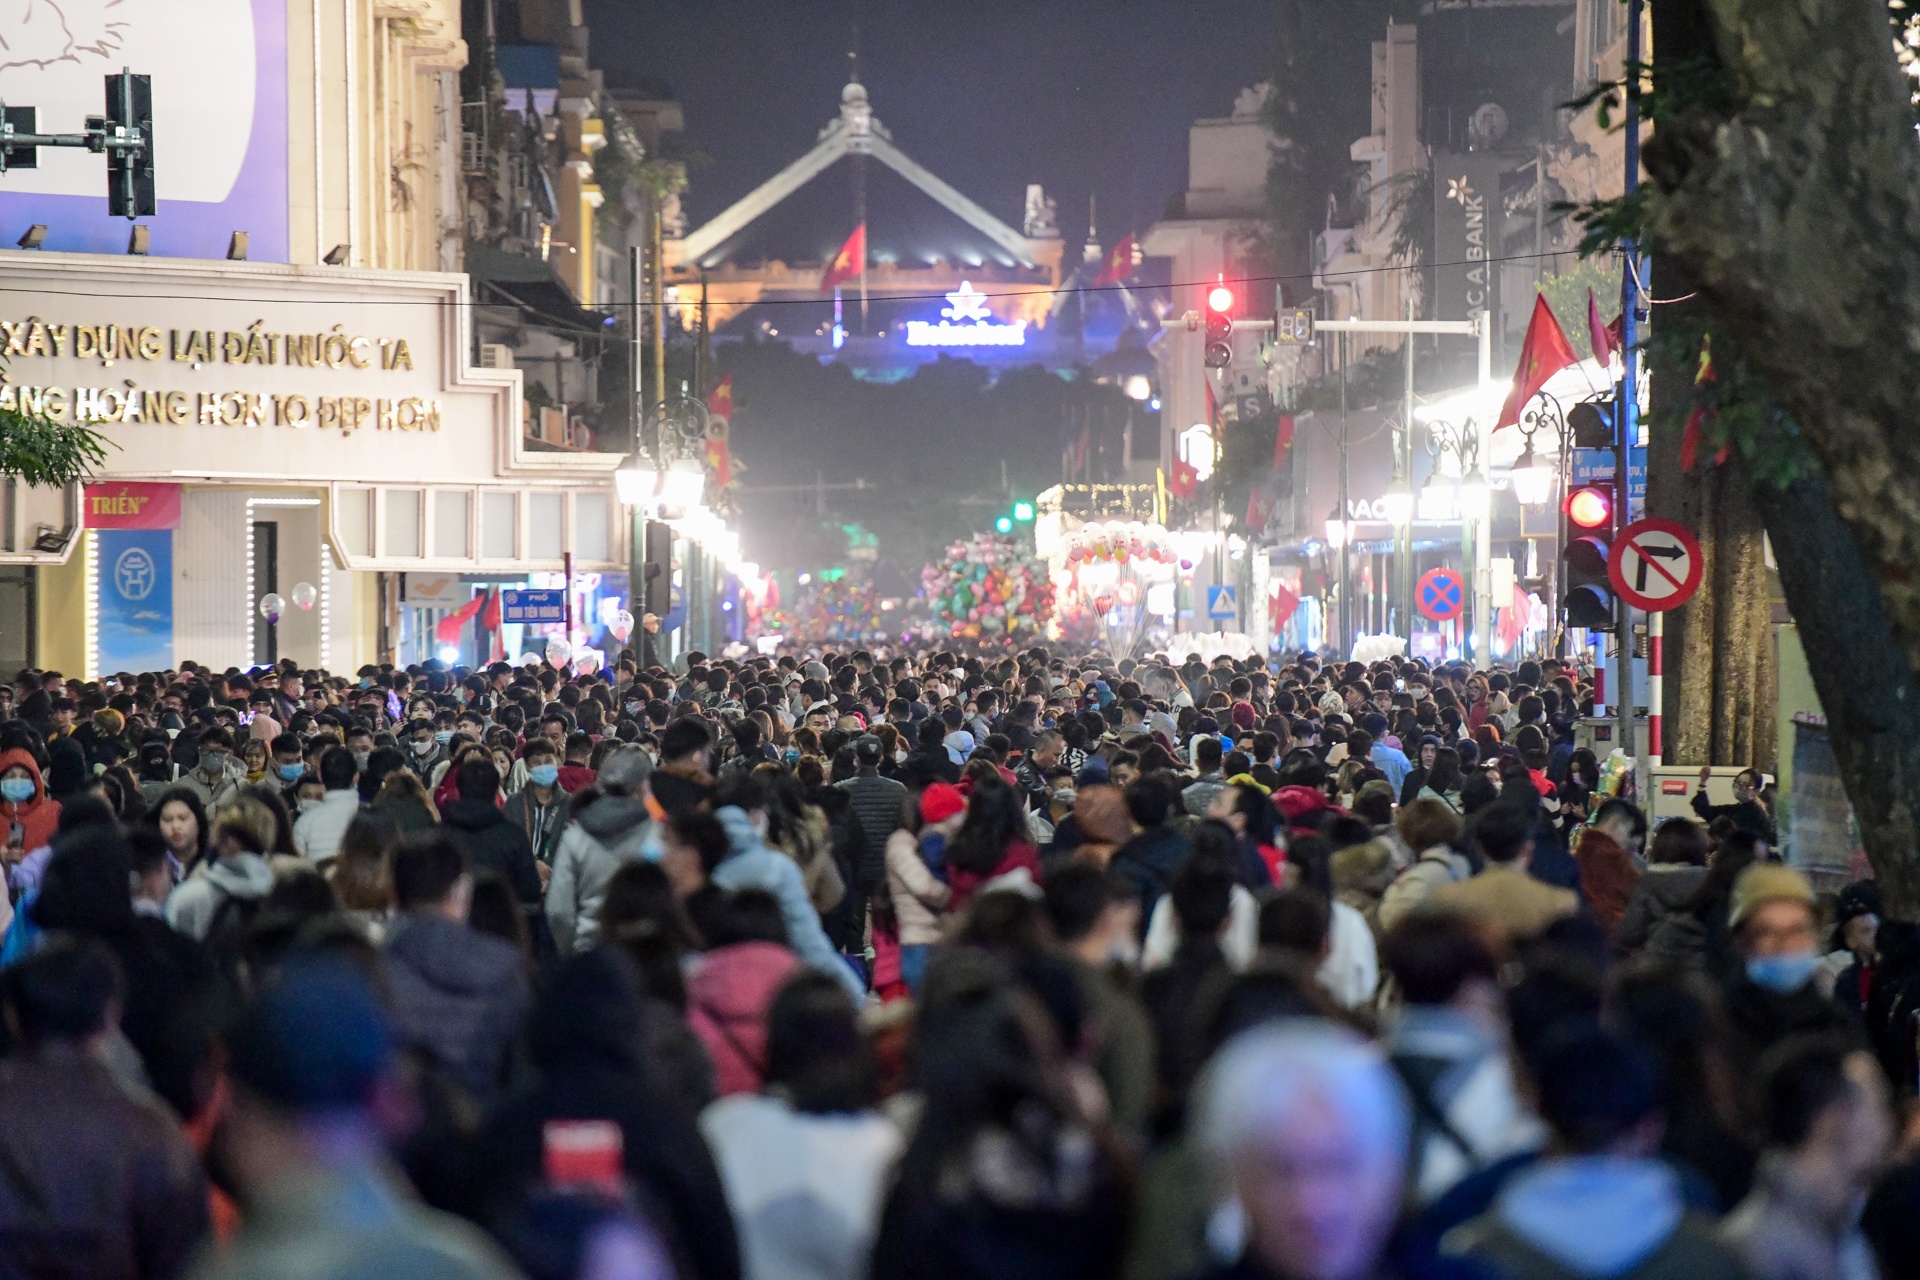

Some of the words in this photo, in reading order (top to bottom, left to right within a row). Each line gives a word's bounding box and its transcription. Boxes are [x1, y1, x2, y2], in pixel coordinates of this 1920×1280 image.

[1465, 194, 1484, 261] BANK
[0, 316, 68, 356] XÂY
[170, 329, 216, 371] LẠI
[222, 319, 280, 365] ĐẤT
[378, 337, 413, 371] TA
[74, 378, 192, 425] HOÀNG
[271, 394, 310, 428] TO
[316, 396, 371, 437] ĐẸP
